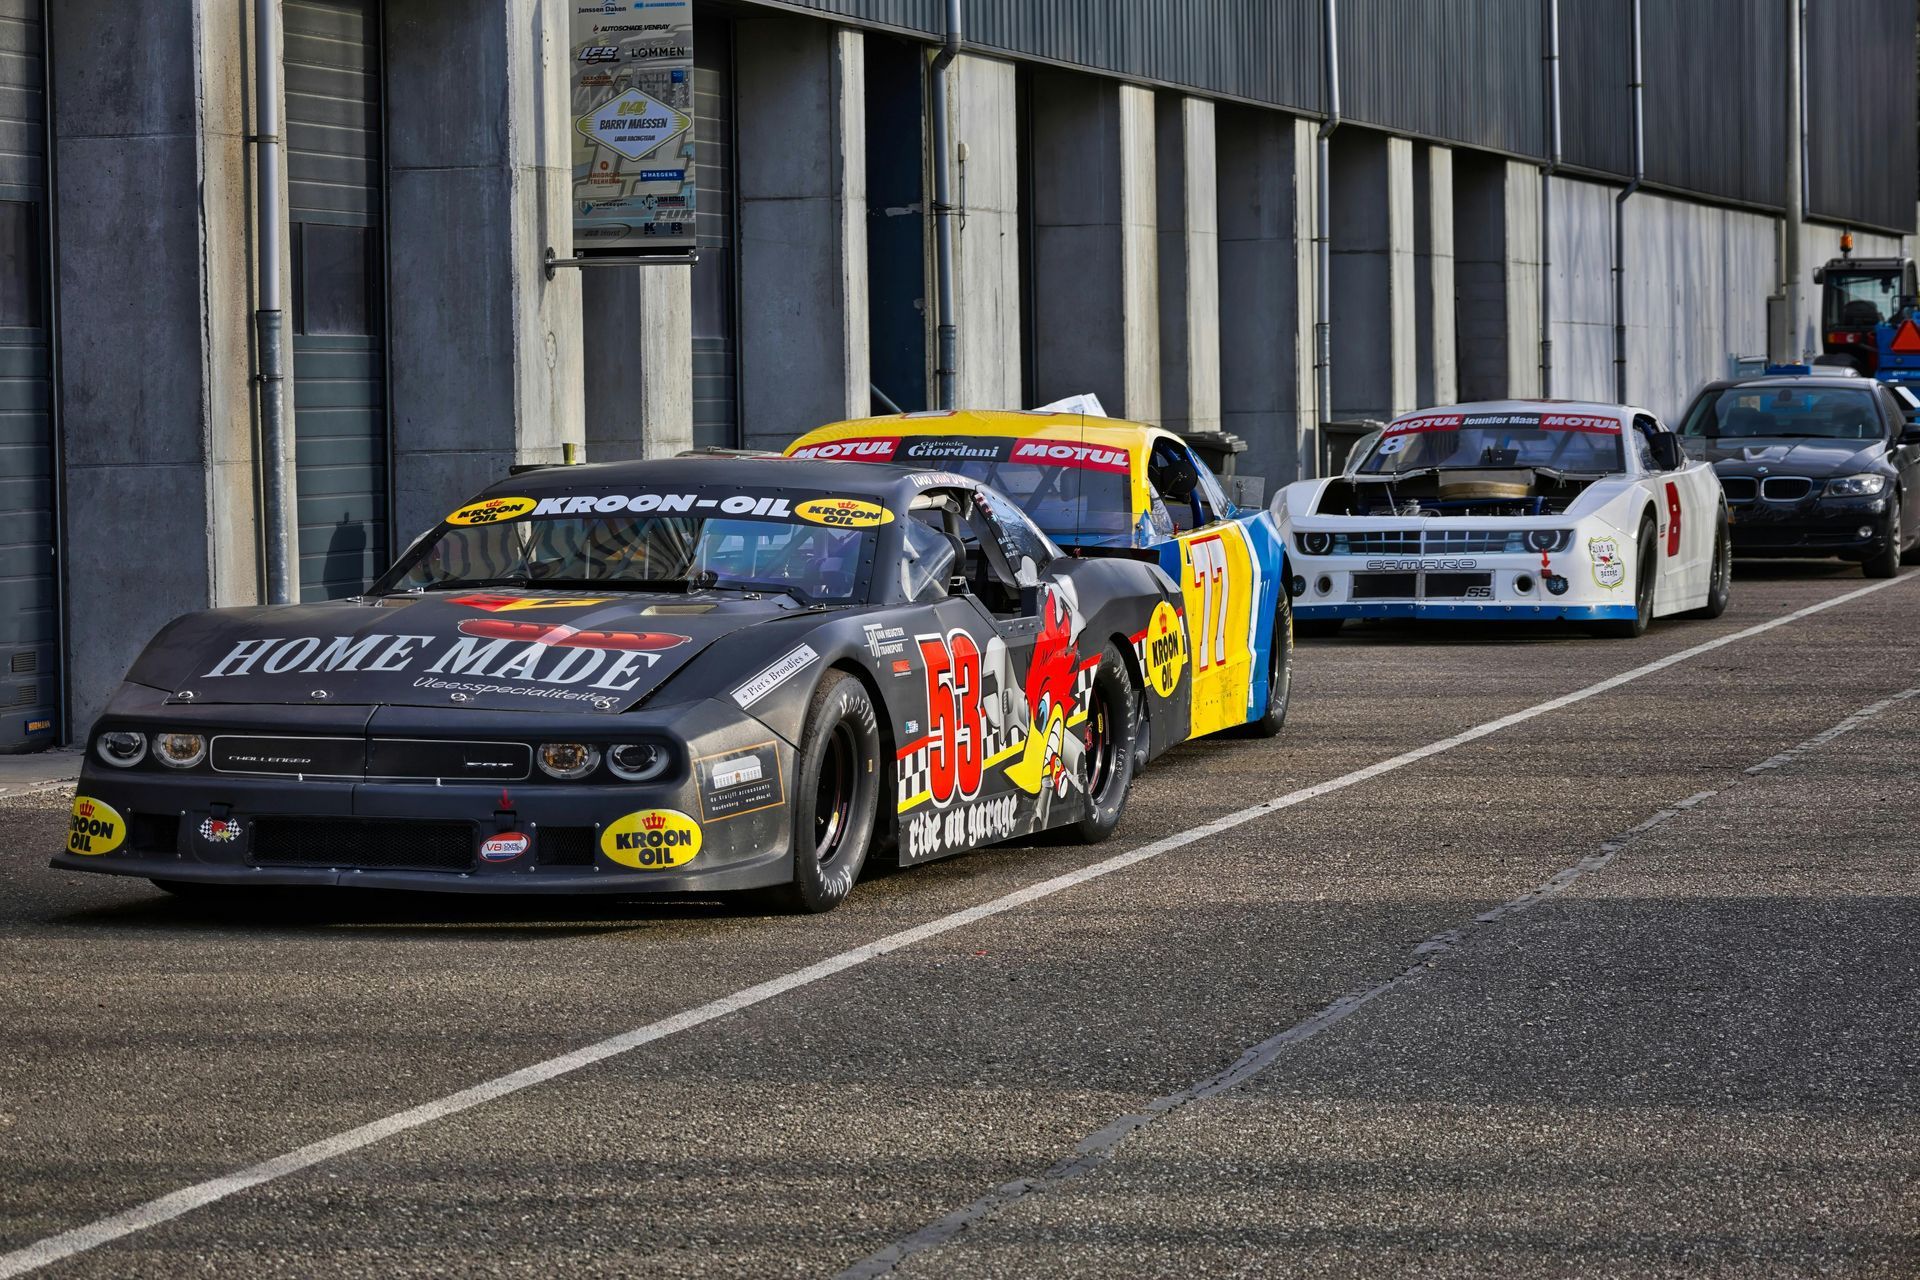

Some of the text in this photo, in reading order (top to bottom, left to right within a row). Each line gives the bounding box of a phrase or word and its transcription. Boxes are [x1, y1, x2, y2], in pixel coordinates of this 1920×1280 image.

[631, 47, 685, 57] LOMMEN
[599, 118, 668, 131] BARRY MAESSEN
[1386, 416, 1460, 433] MOTUL
[1463, 415, 1540, 426] Jennifer Maas
[1543, 416, 1621, 430] MOTUL
[792, 441, 894, 459] MOTUL
[908, 446, 999, 458] Giordani
[1378, 435, 1407, 455] 8
[1016, 443, 1129, 467] MOTUL
[457, 503, 524, 518] KROON
[531, 494, 792, 518] KROON-OIL
[808, 505, 881, 520] KROON
[469, 514, 498, 523] OIL
[823, 515, 854, 525] OIL
[1366, 559, 1478, 570] CAMARO
[1466, 586, 1492, 598] SS
[1189, 534, 1231, 673] 77
[1151, 630, 1179, 668] KROON
[200, 634, 662, 692] HOME MADE
[746, 656, 805, 697] Piet's Broodjes
[1161, 662, 1173, 692] OIL
[914, 628, 984, 809] 53
[72, 815, 115, 840] ROON
[908, 793, 1018, 858] ride on garage
[70, 832, 92, 852] OIL
[486, 843, 502, 852] V8
[616, 829, 692, 850] KROON
[638, 847, 675, 866] OIL
